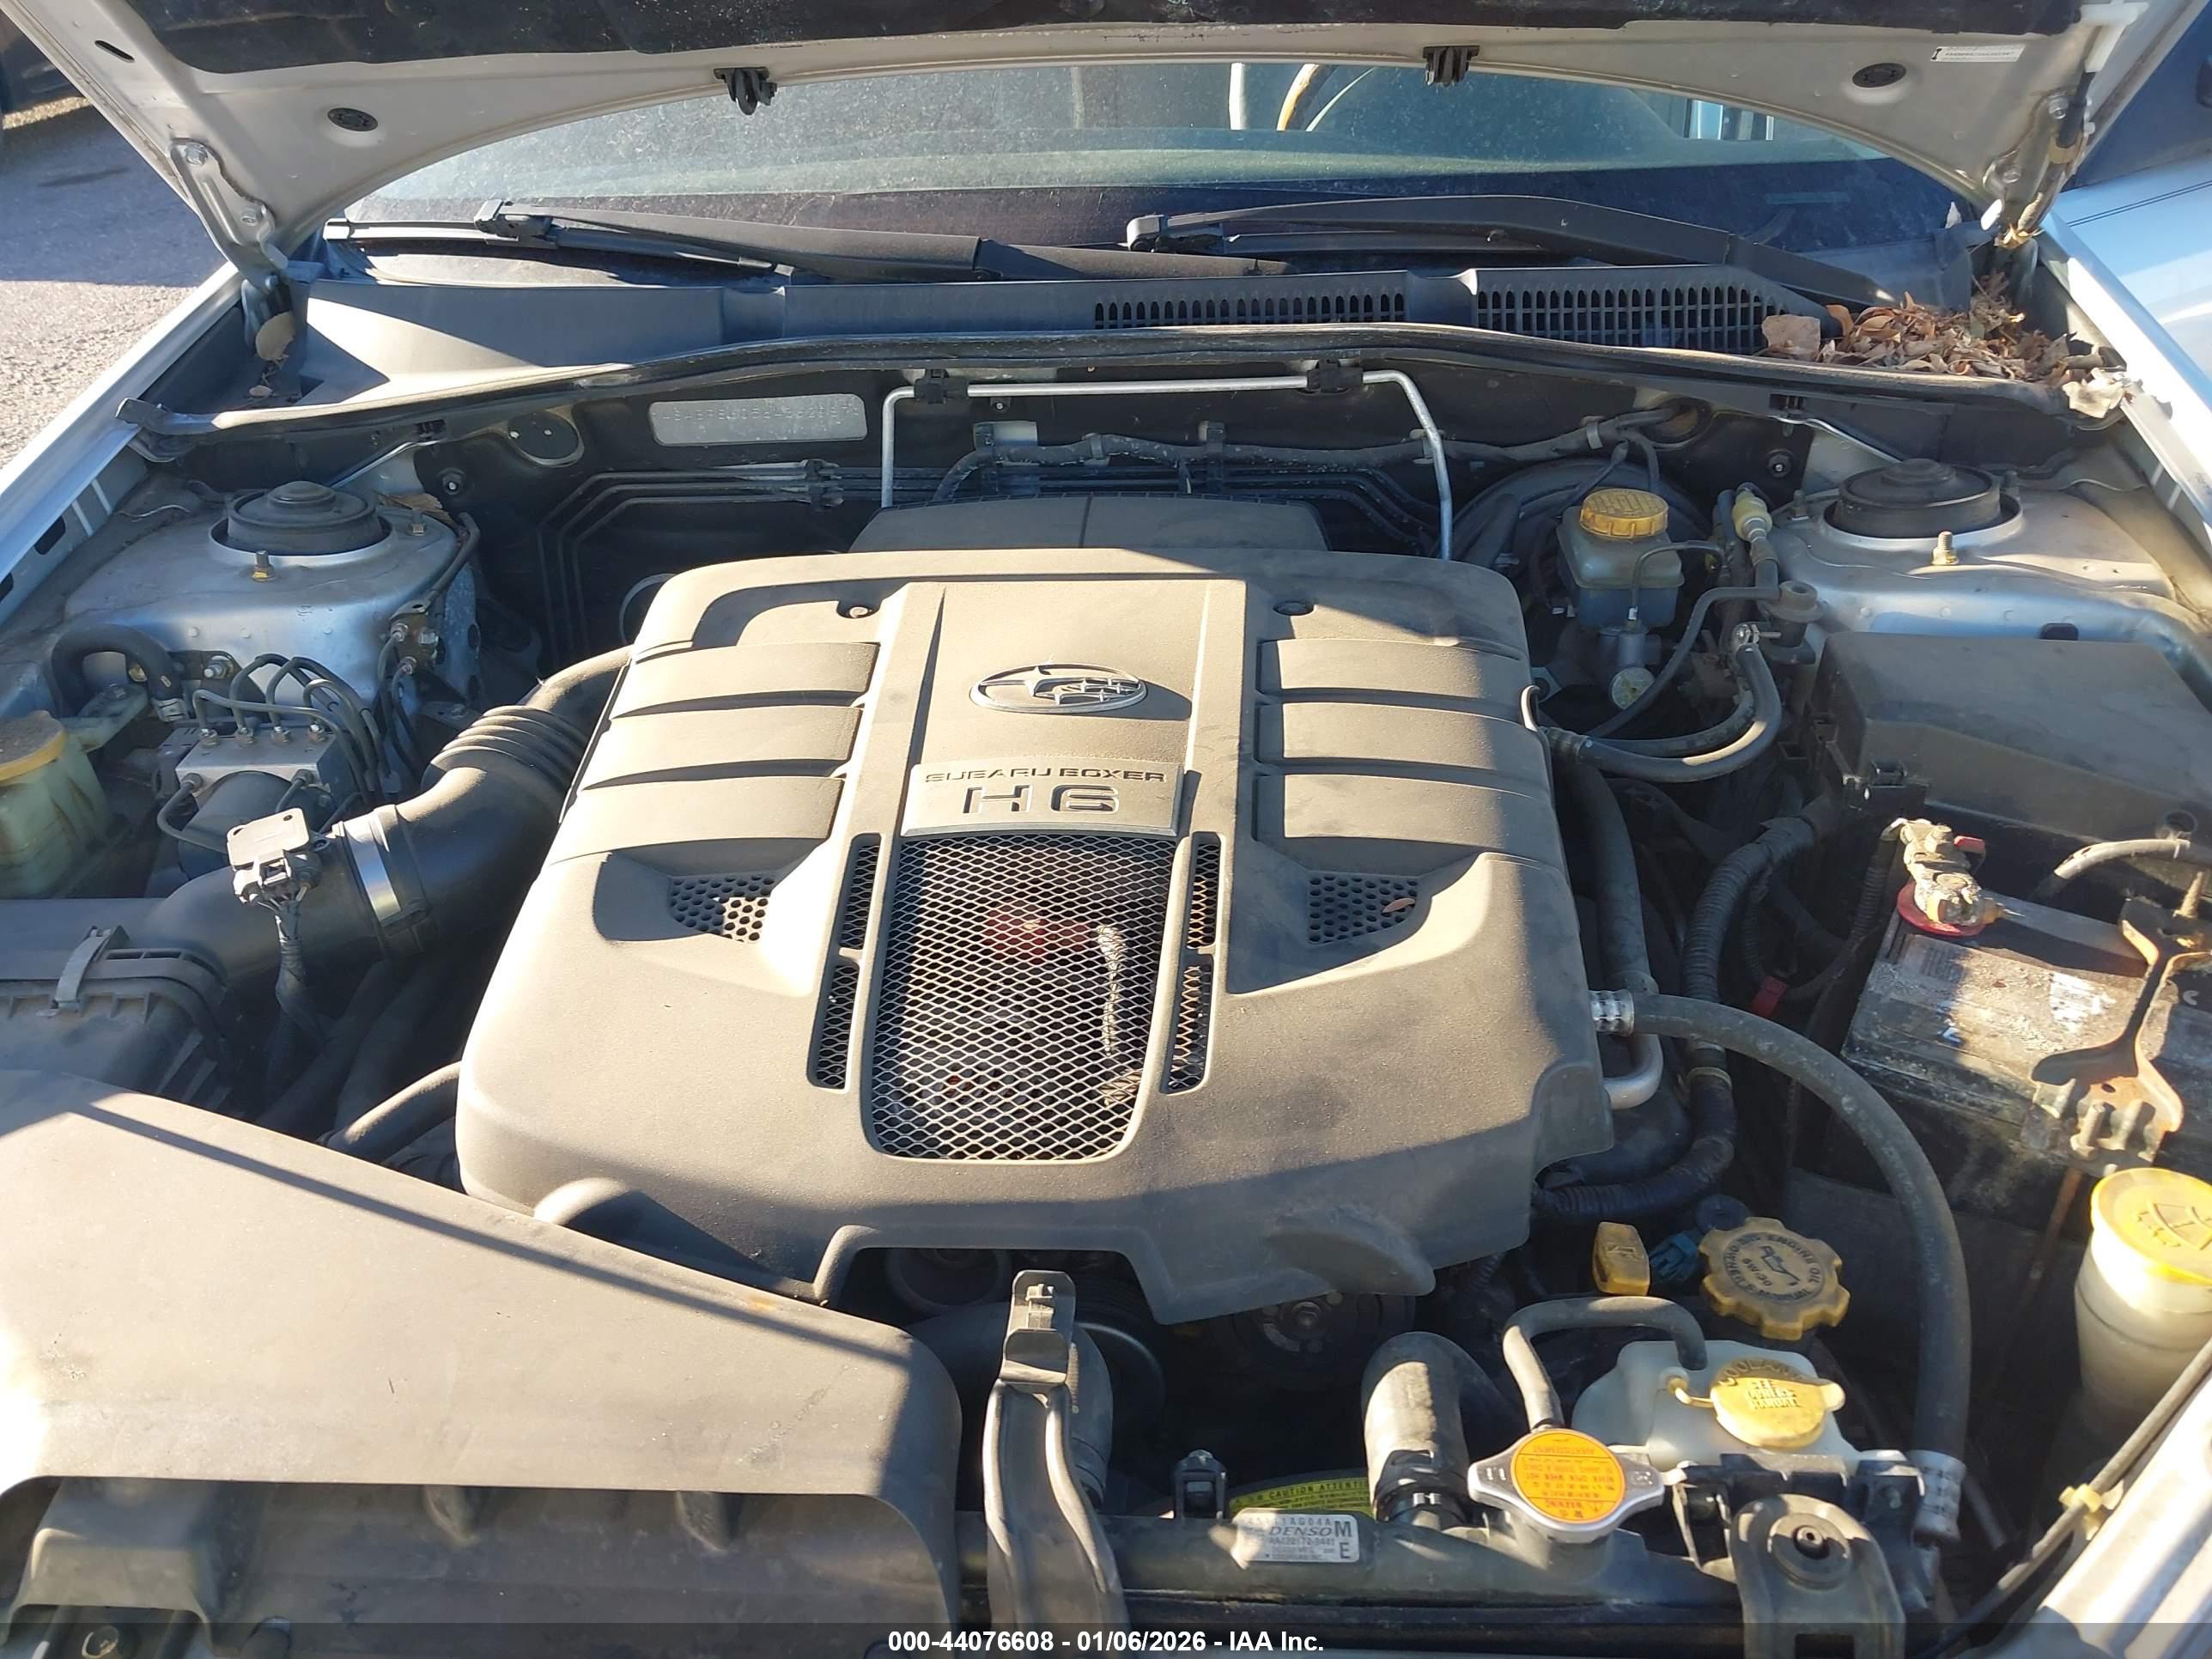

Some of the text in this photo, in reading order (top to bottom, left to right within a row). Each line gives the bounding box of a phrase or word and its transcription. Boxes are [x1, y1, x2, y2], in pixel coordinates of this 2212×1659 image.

[926, 768, 1166, 782] SUBARU BOXER
[1808, 1267, 1820, 1283] OIL
[1269, 1486, 1314, 1500] CAUTION
[1269, 1527, 1332, 1536] DENSO
[1334, 1521, 1352, 1538] M
[1340, 1542, 1351, 1559] E
